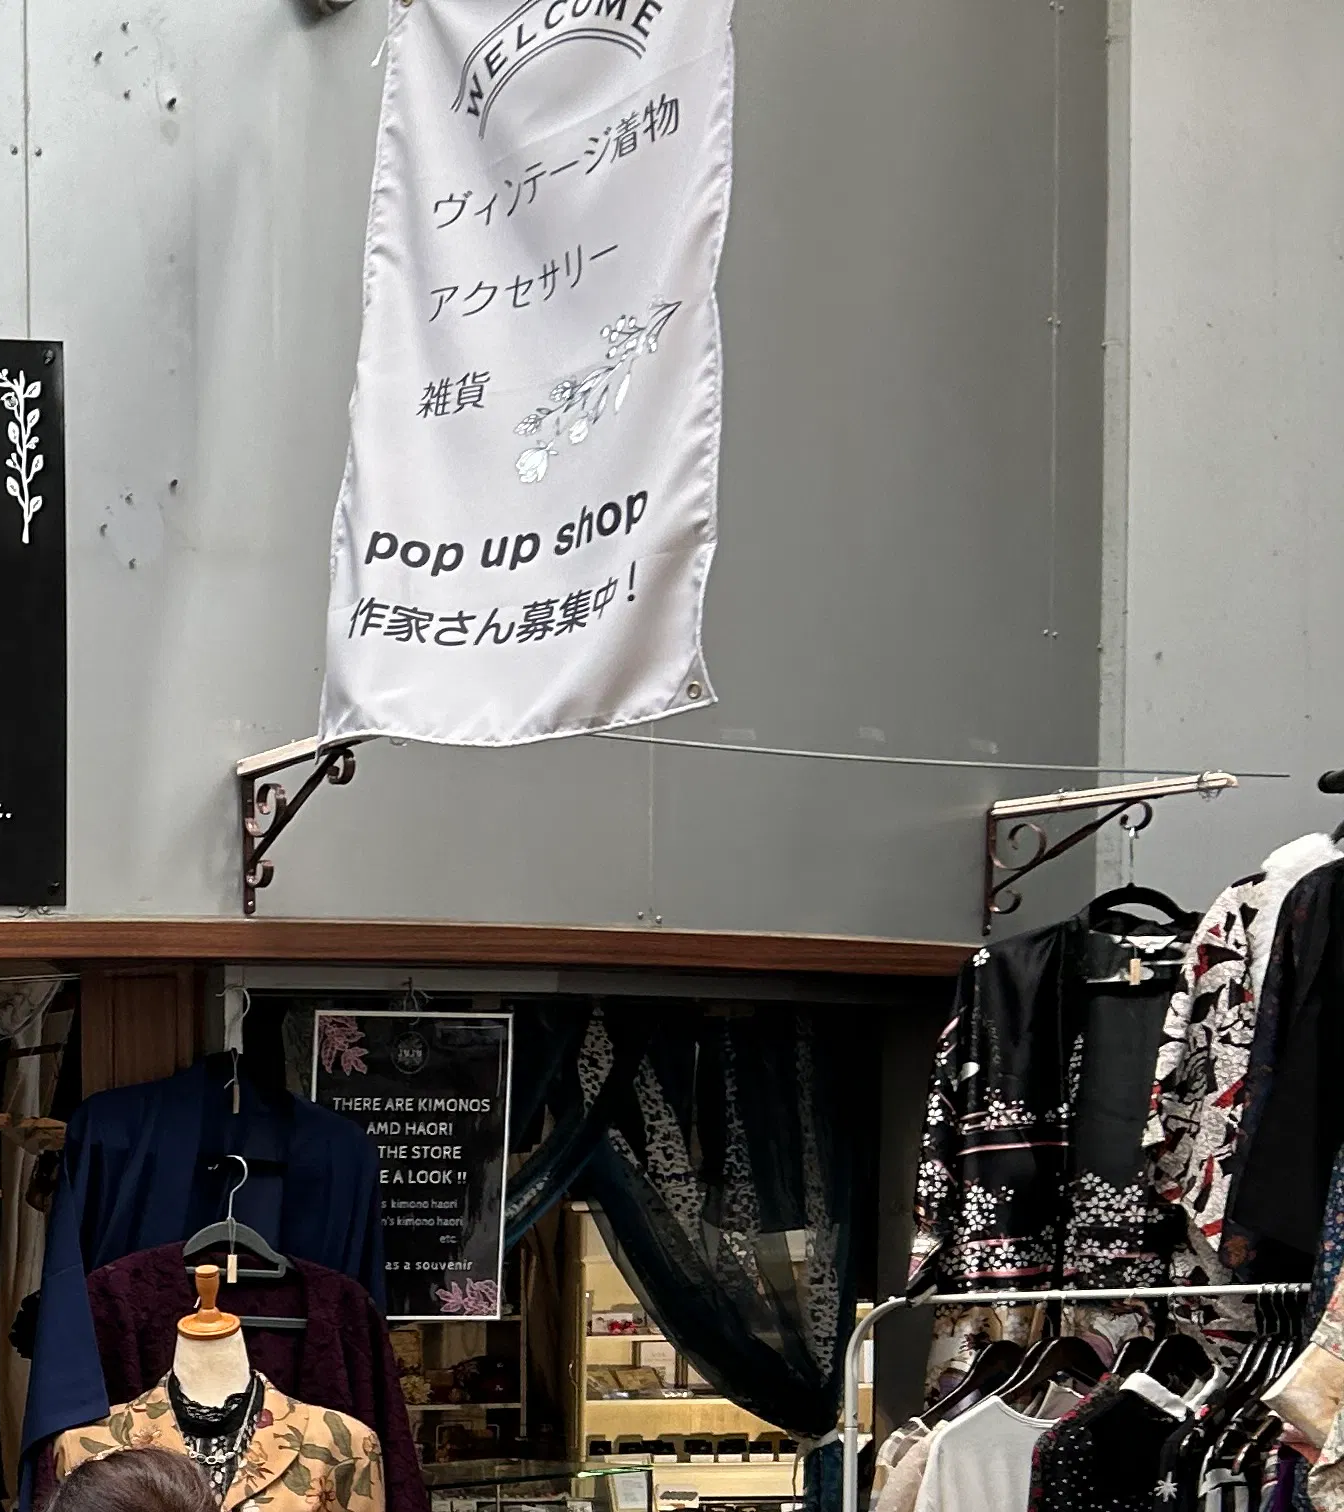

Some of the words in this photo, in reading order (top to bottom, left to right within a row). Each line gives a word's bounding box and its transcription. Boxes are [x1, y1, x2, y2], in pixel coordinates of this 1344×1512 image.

[466, 0, 663, 118] WELCOME
[432, 93, 680, 229] ヴィンテージ着物
[429, 244, 619, 322] アクセサリー
[416, 371, 491, 419] 雑貨
[365, 530, 464, 577] pop
[480, 531, 541, 571] up
[553, 489, 649, 556] shop
[332, 1097, 381, 1112] THERE
[384, 1097, 414, 1112] ARE
[417, 1097, 491, 1113] KIMONOS
[366, 1121, 401, 1136] AMD
[405, 1121, 453, 1136] HAORI
[378, 1145, 408, 1160] THE
[411, 1145, 462, 1160] STORE
[393, 1170, 405, 1184] A
[407, 1170, 453, 1185] LOOK
[391, 1198, 429, 1209] kimono
[396, 1216, 435, 1227] kimono
[384, 1261, 400, 1271] as
[403, 1262, 411, 1271] a
[415, 1258, 473, 1271] souvenir
